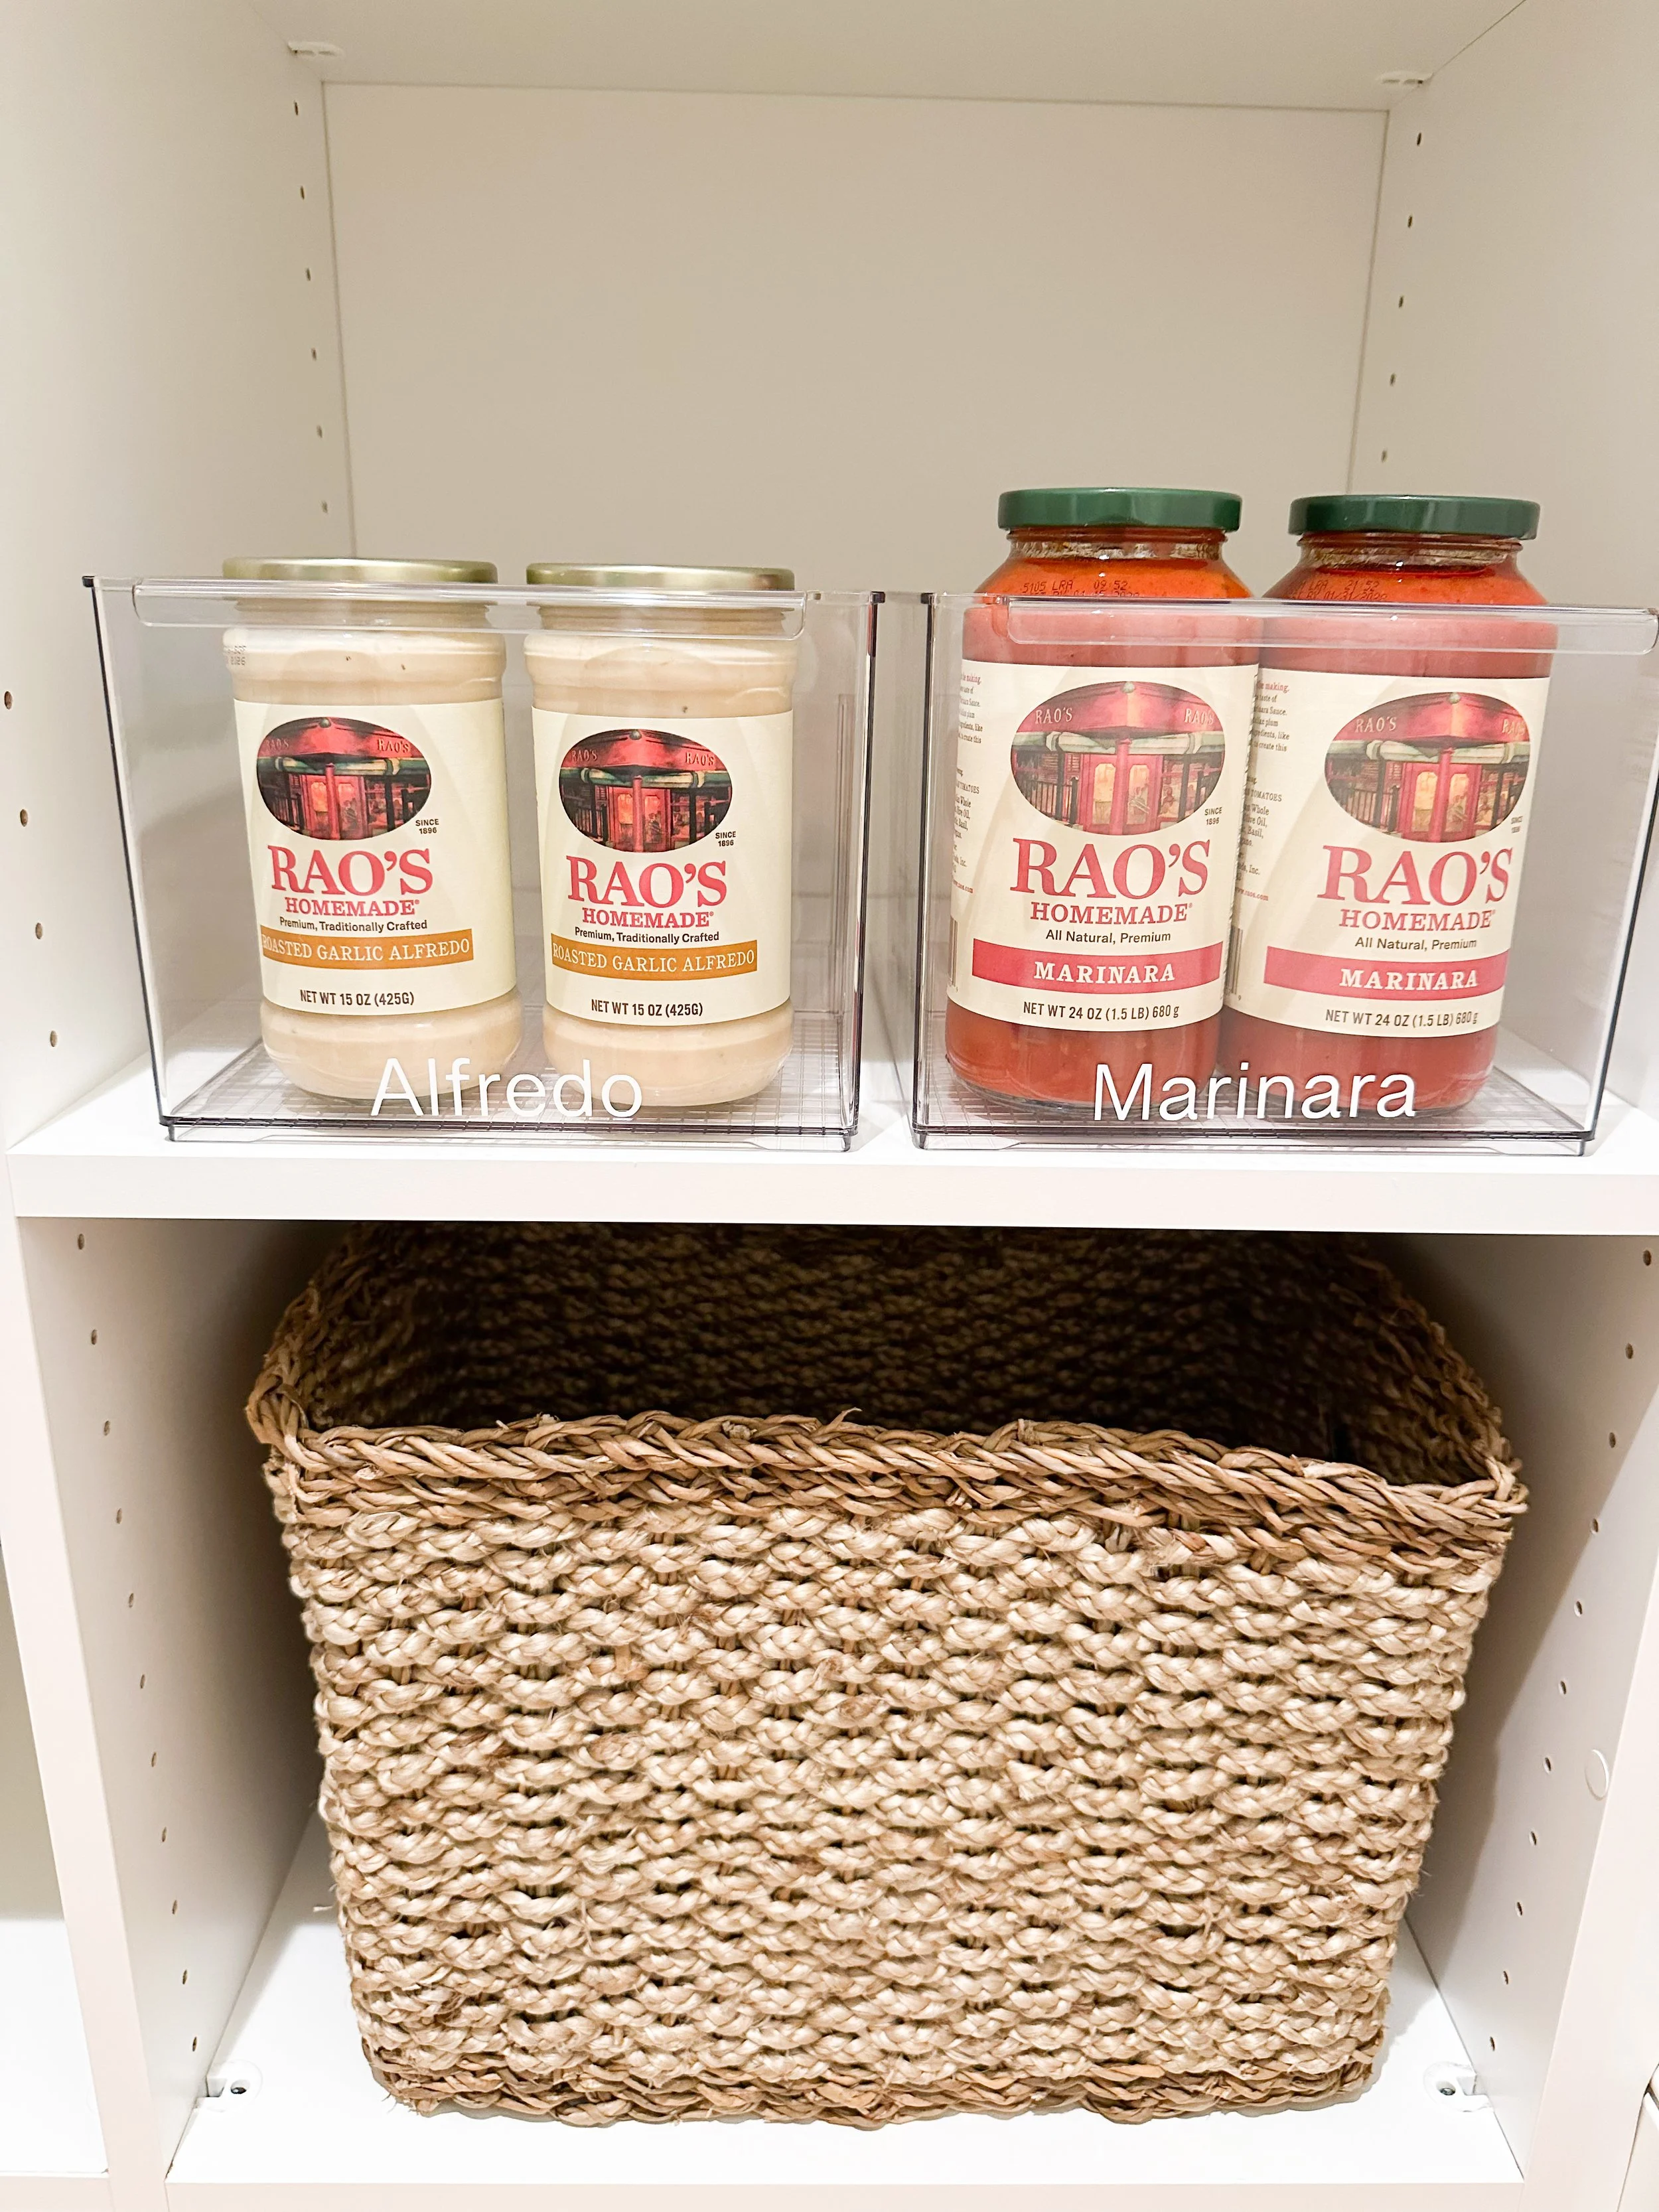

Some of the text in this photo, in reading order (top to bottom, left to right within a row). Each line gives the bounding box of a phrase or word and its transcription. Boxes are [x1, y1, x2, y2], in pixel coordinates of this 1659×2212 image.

[1035, 707, 1073, 725] RAO'S
[1356, 716, 1397, 733] RAO'S
[378, 738, 411, 754] RAO'S
[571, 749, 597, 763] RAO'S
[685, 751, 715, 766] RAO'S
[1204, 806, 1222, 816] SINCE
[415, 818, 439, 827] SINCE
[715, 831, 736, 840] SINCE
[718, 839, 735, 848] 1896
[267, 844, 434, 897] RAO'S
[1010, 837, 1210, 899] RAO'S
[1317, 844, 1514, 907] RAO'S
[566, 855, 727, 909] RAO'S
[279, 916, 428, 933] Premium, Traditionally Crafted
[575, 926, 719, 945] Premium, Traditionally Crafted
[1045, 928, 1171, 946] All Natural, Premium
[1355, 936, 1477, 952] All Natural, Premium
[261, 933, 470, 962] ROASTED GARLIC ALFREDO
[552, 942, 755, 972] ROASTED GARLIC ALFREDO
[1034, 961, 1175, 984] MARINARA
[1339, 968, 1479, 992] MARINARA
[300, 990, 415, 1007] NET WT 15 OZ (425G)
[591, 999, 703, 1018] NET WT 15 OZ (425G)
[1023, 1001, 1180, 1021] NET WT 24 OZ (1.5 LB) 680 g
[1325, 1009, 1479, 1029] NET WT 24 OZ (1.5 LB) 680 g
[370, 1057, 642, 1119] Alfredo
[1094, 1061, 1416, 1122] Marinara
